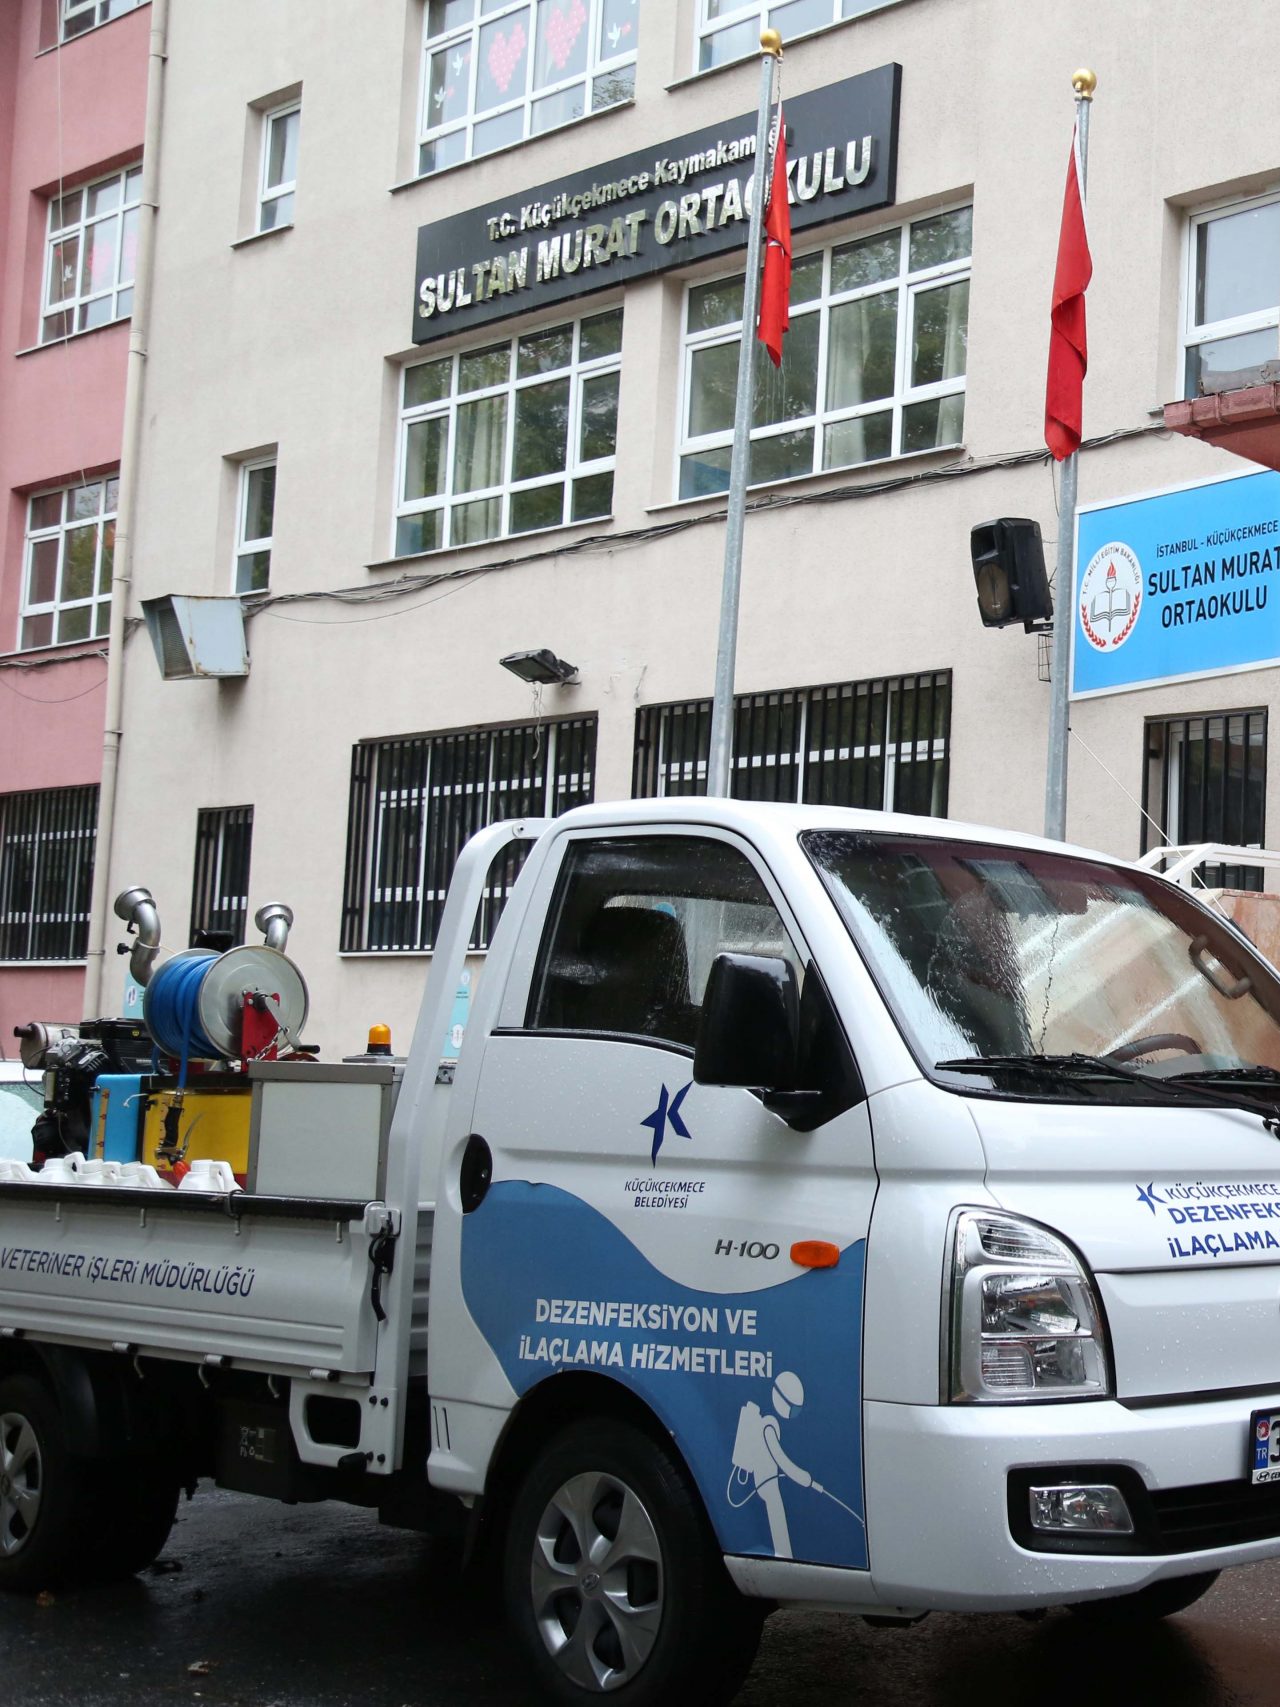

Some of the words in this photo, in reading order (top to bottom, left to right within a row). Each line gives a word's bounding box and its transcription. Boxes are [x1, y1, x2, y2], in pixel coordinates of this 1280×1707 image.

[487, 212, 517, 241] T.C.
[520, 171, 650, 231] Küçükçekmece
[654, 124, 787, 186] Kaymakamğ
[418, 246, 529, 319] SULTAN
[535, 208, 647, 283] MURAT
[1156, 538, 1199, 559] İSTANBUL
[1206, 519, 1279, 547] KÜÇÜKÇEKMECE
[1147, 560, 1216, 597] SULTAN
[1161, 585, 1268, 629] ORTAOKULU
[624, 1177, 706, 1194] KÜÇÜKÇEKMECE
[634, 1194, 689, 1209] BELEDİYESİ
[1164, 1181, 1279, 1201] KÜÇÜKÇEKMECE
[714, 1238, 781, 1260] H-100
[0, 1247, 86, 1278] VETERİNER
[87, 1256, 140, 1284] İŞLERİ
[140, 1258, 256, 1298] MÜDÜRLÜĞÜ
[725, 1308, 758, 1336] VE
[1256, 1447, 1268, 1461] TR
